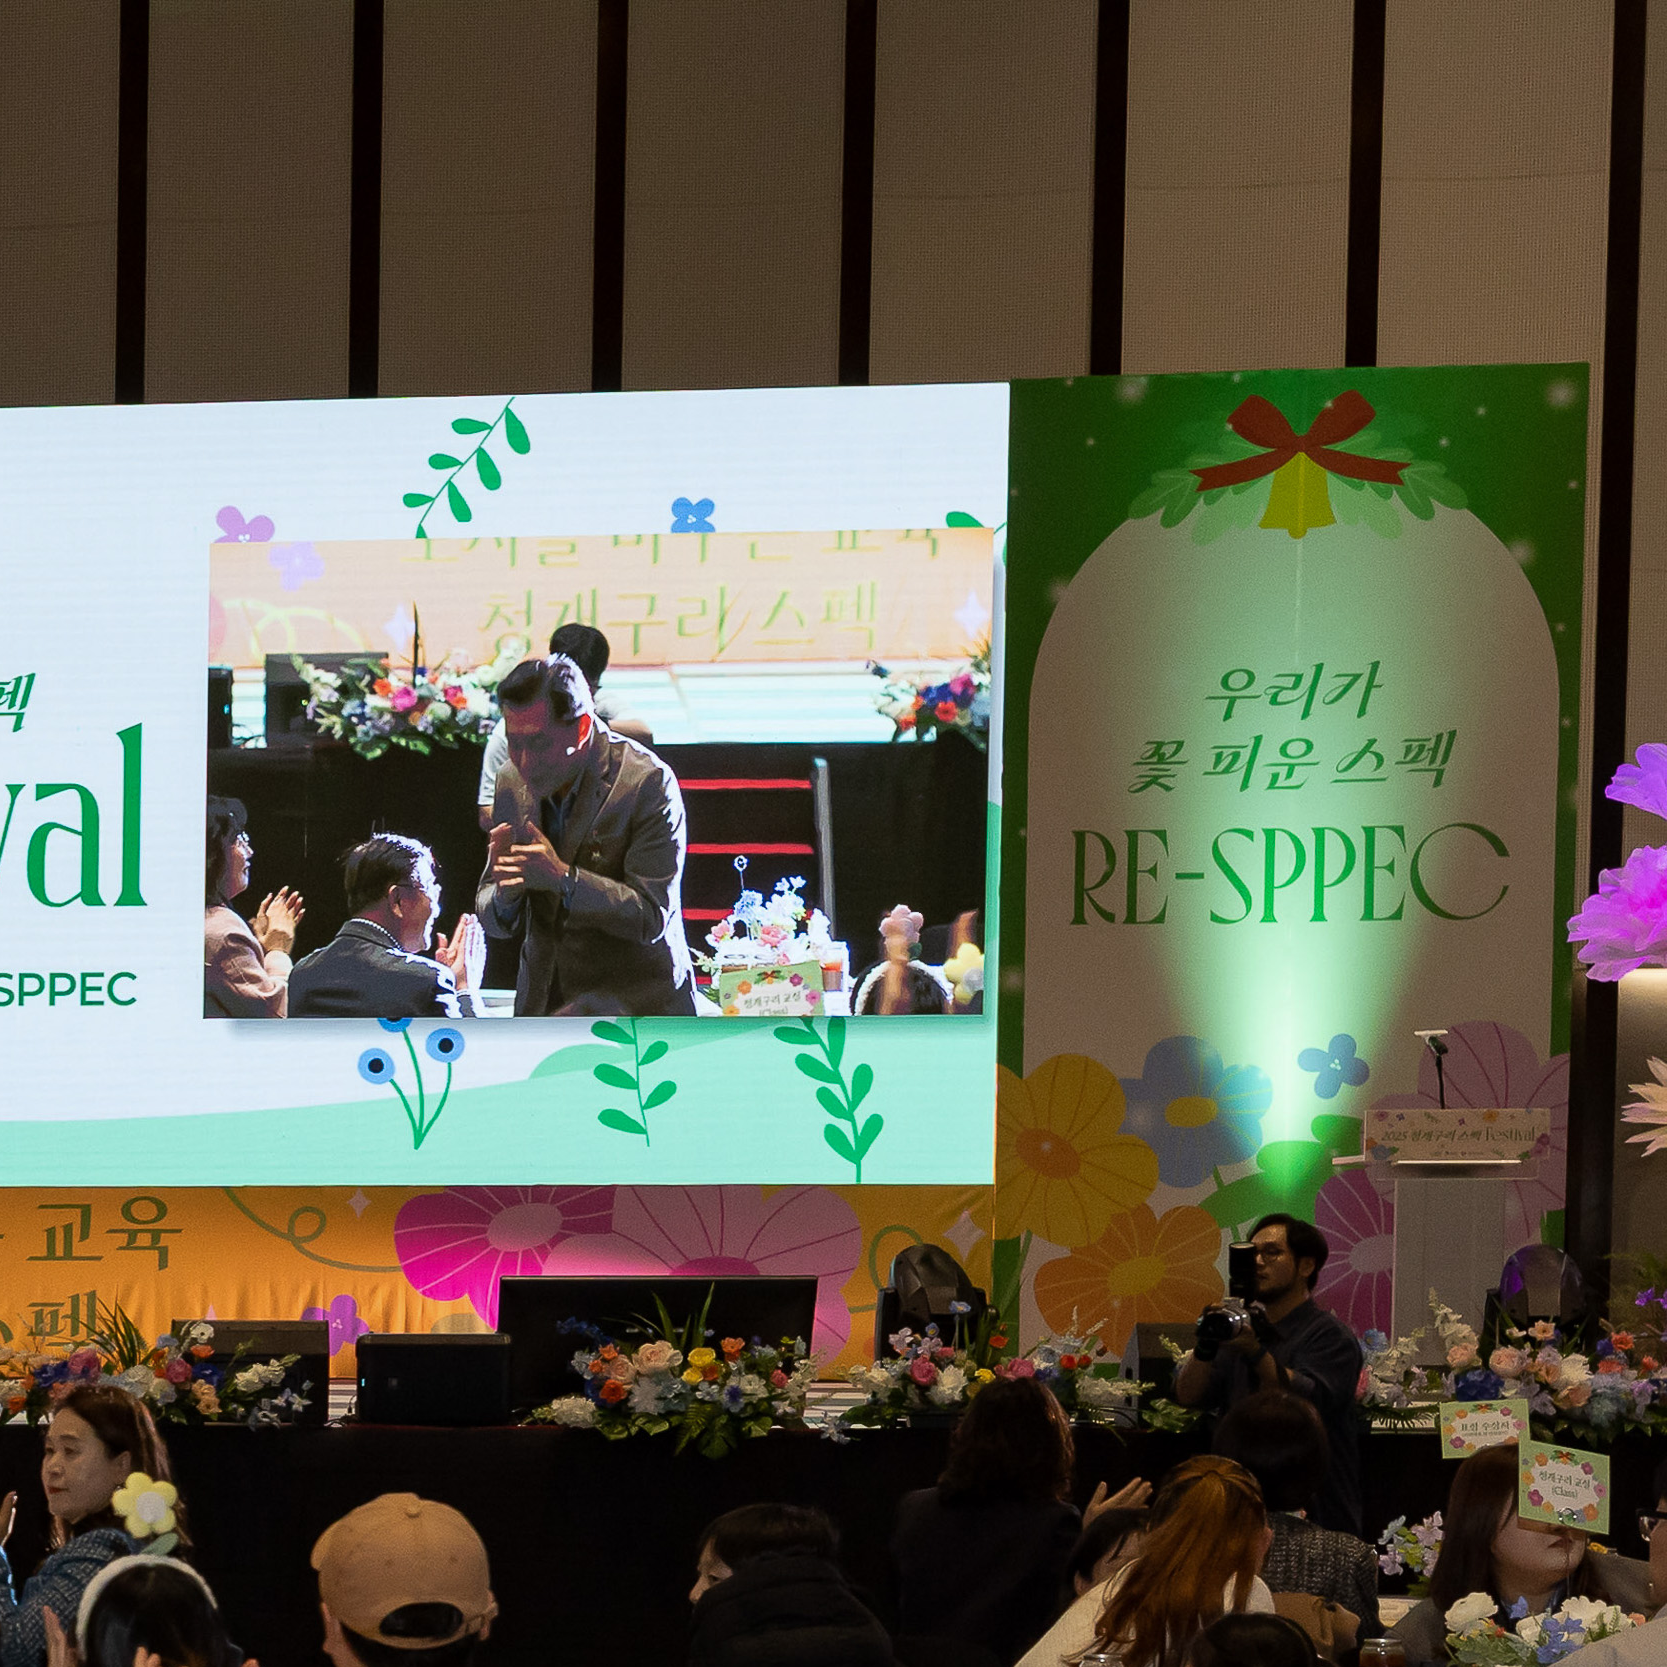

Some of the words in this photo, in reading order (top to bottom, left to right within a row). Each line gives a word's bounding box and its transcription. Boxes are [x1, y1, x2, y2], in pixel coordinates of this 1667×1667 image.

[753, 580, 880, 652] 스펙
[1205, 661, 1383, 722] 우리가
[1128, 739, 1189, 793] 꽃
[1202, 734, 1320, 792] 피운
[1331, 729, 1457, 788] 스펙
[1069, 823, 1510, 925] RE-SPPEC
[25, 1195, 184, 1272] 교육
